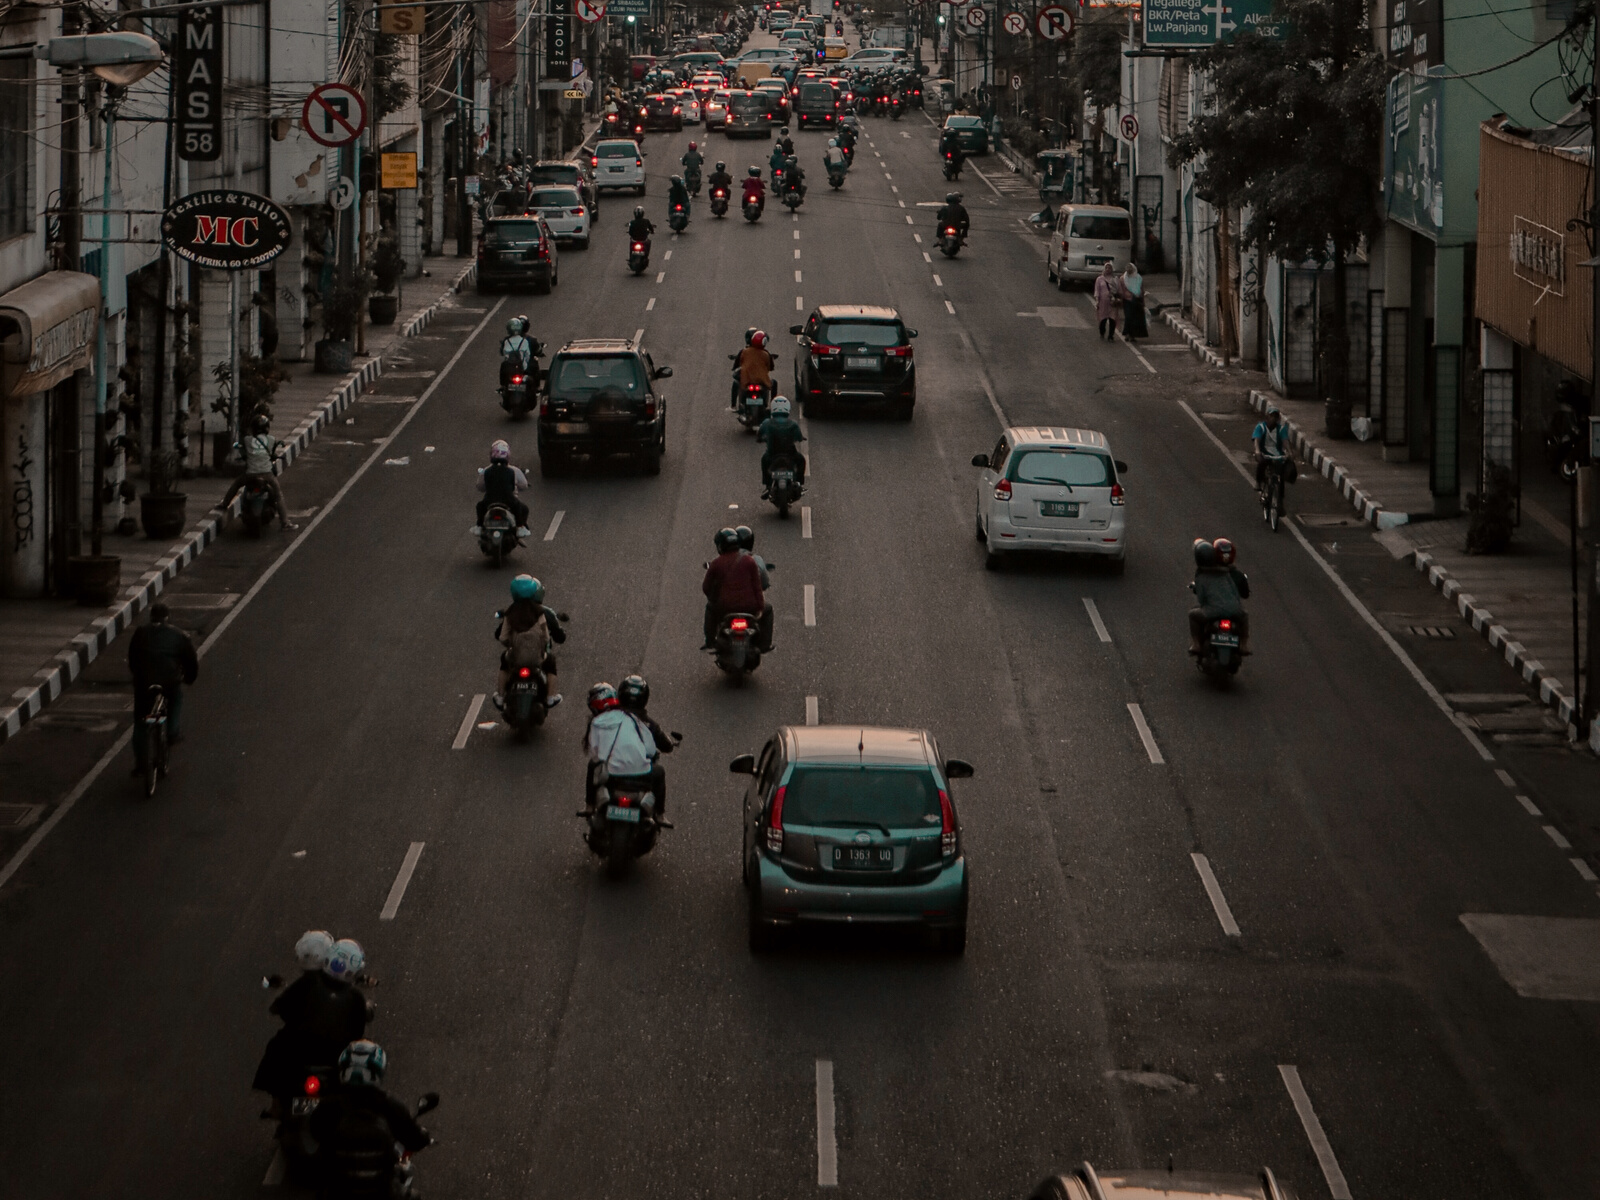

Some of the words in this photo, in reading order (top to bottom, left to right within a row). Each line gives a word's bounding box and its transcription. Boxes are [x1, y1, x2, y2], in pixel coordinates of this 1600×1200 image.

[1148, 10, 1200, 22] BKR/Peta
[555, 3, 564, 56] ZODIAK
[1148, 22, 1208, 36] Lw.Panjang
[323, 97, 349, 134] P
[184, 132, 213, 153] 58
[166, 193, 222, 220] Textile
[225, 193, 237, 204] &
[241, 195, 285, 227] Tailor
[191, 214, 260, 248] MC
[176, 246, 196, 261] ASIA
[195, 255, 228, 268] AFRIKA
[229, 260, 242, 268] 60
[835, 848, 842, 860] D
